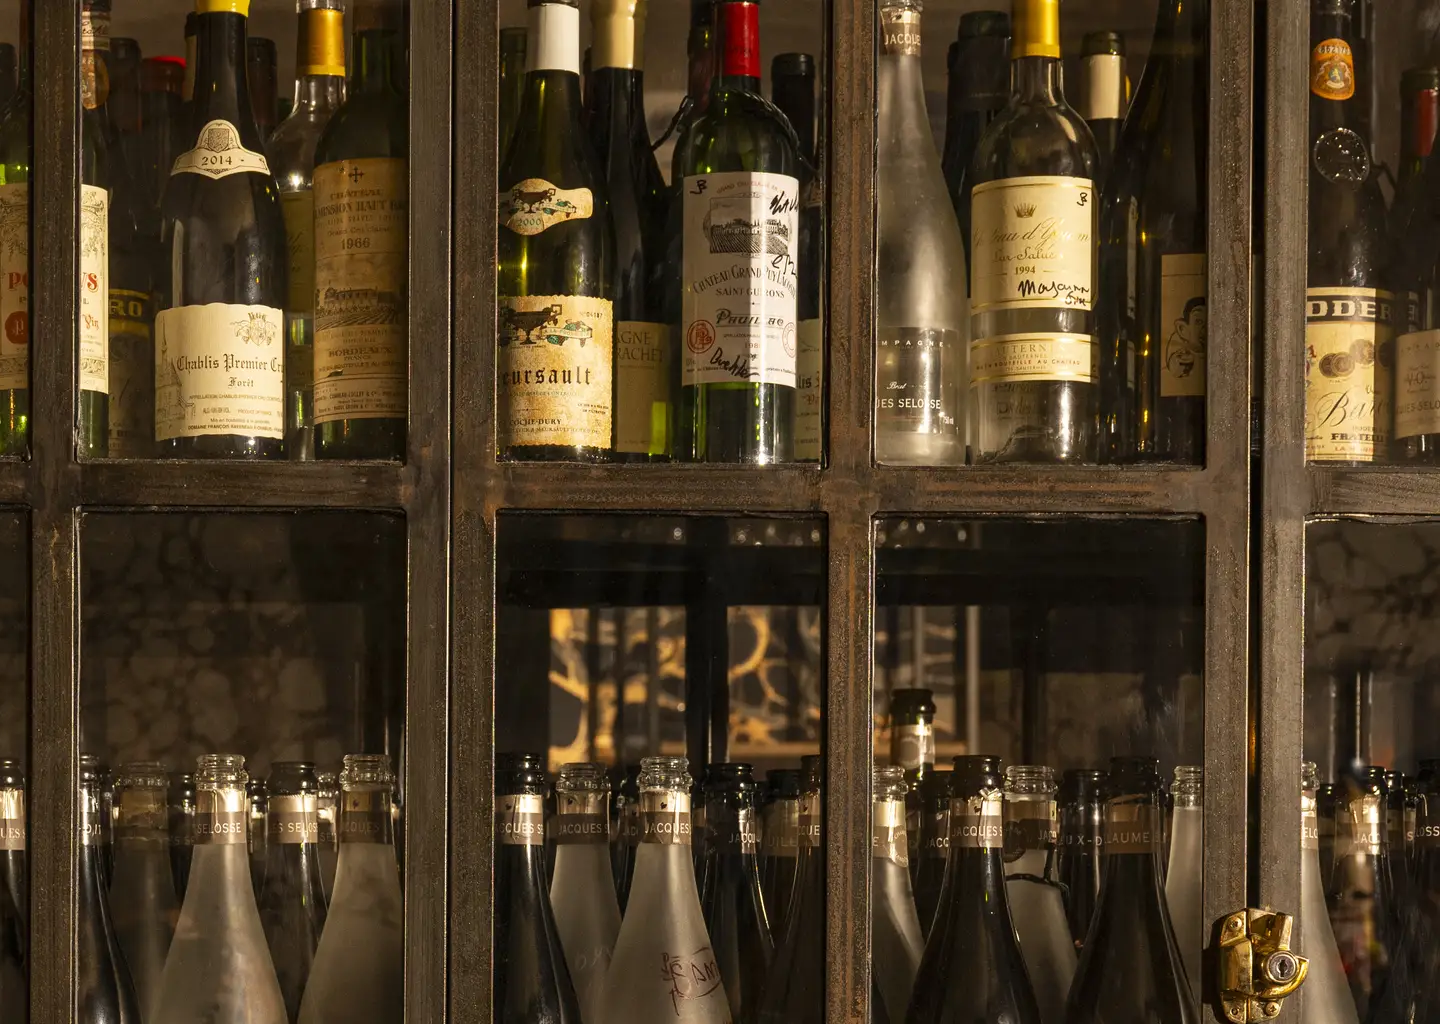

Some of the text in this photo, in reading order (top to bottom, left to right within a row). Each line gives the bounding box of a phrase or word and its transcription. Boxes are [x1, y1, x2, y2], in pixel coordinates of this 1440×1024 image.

[201, 155, 233, 167] 2014
[515, 218, 542, 227] 2000
[341, 237, 371, 250] 1966
[732, 263, 761, 280] GRAND
[1014, 265, 1036, 275] 1994
[716, 286, 745, 297] SAINT
[177, 353, 268, 374] Chablis Premier
[228, 377, 254, 389] Forêt
[196, 821, 242, 835] SELOSSE
